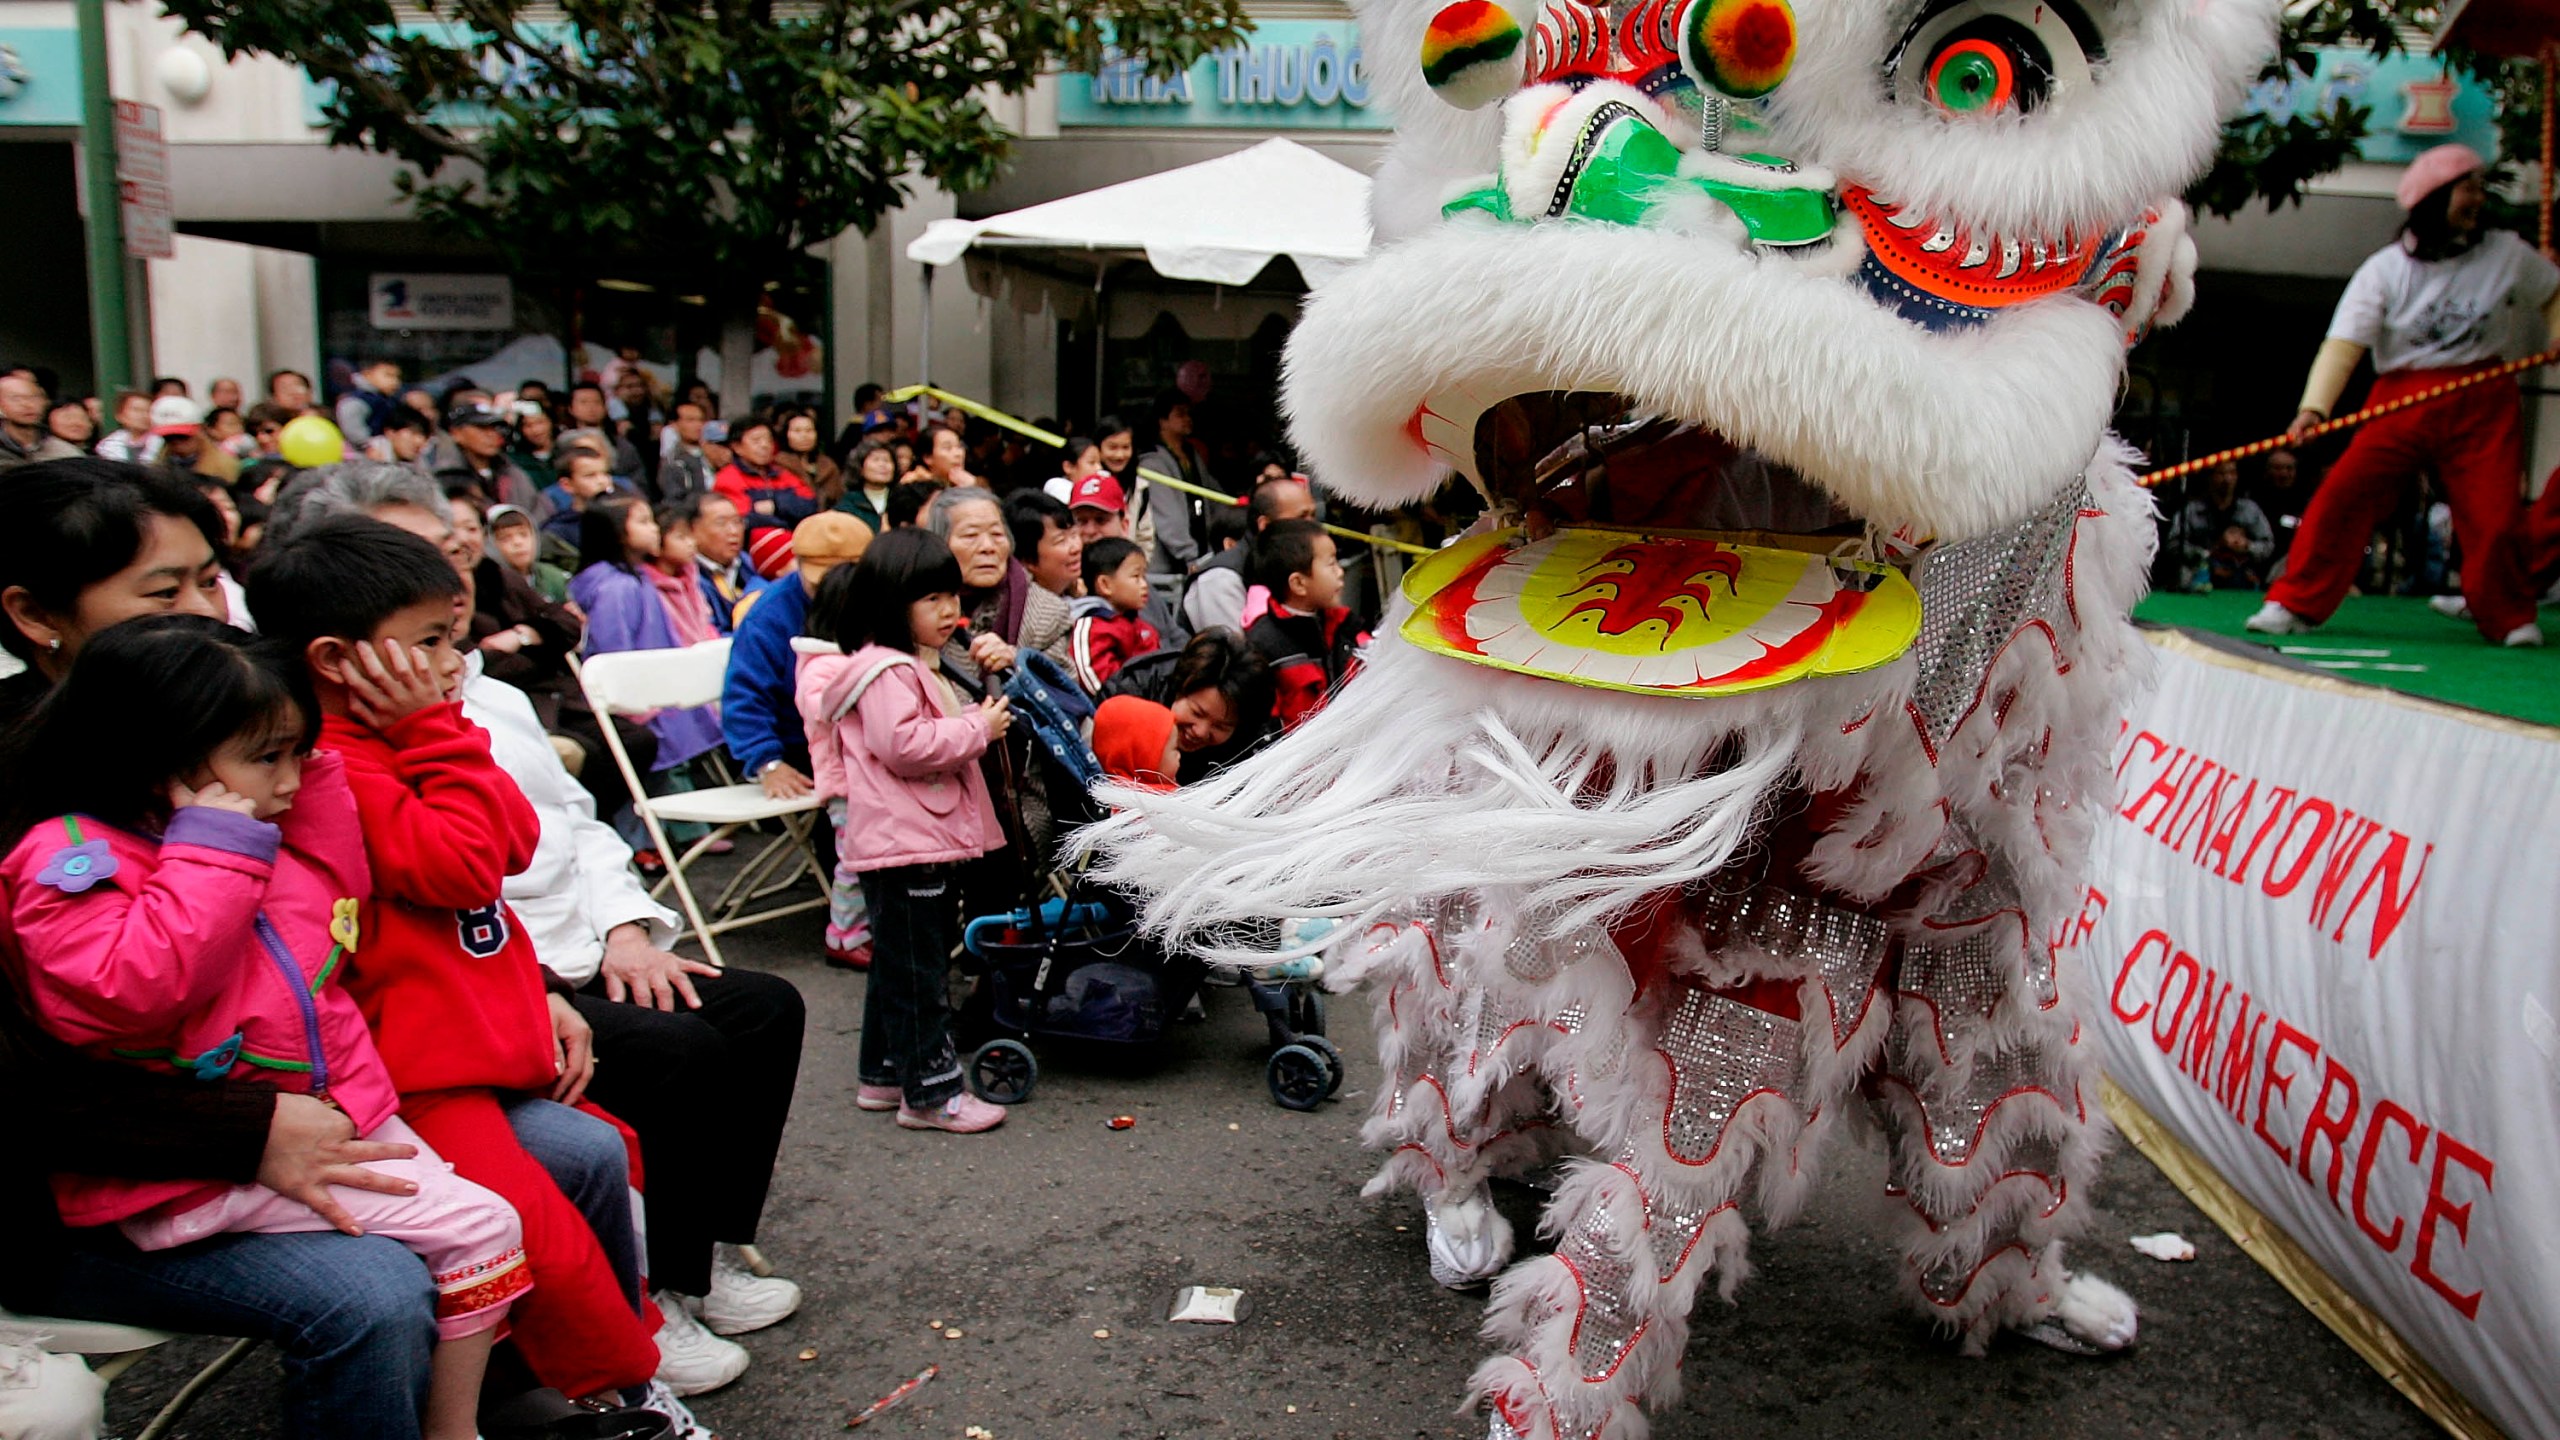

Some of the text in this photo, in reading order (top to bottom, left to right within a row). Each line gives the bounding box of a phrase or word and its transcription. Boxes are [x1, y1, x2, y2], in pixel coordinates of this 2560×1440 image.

[455, 897, 510, 958] 8
[2113, 730, 2435, 961] CHINATOWN
[2110, 929, 2495, 1322] COMMERCE
